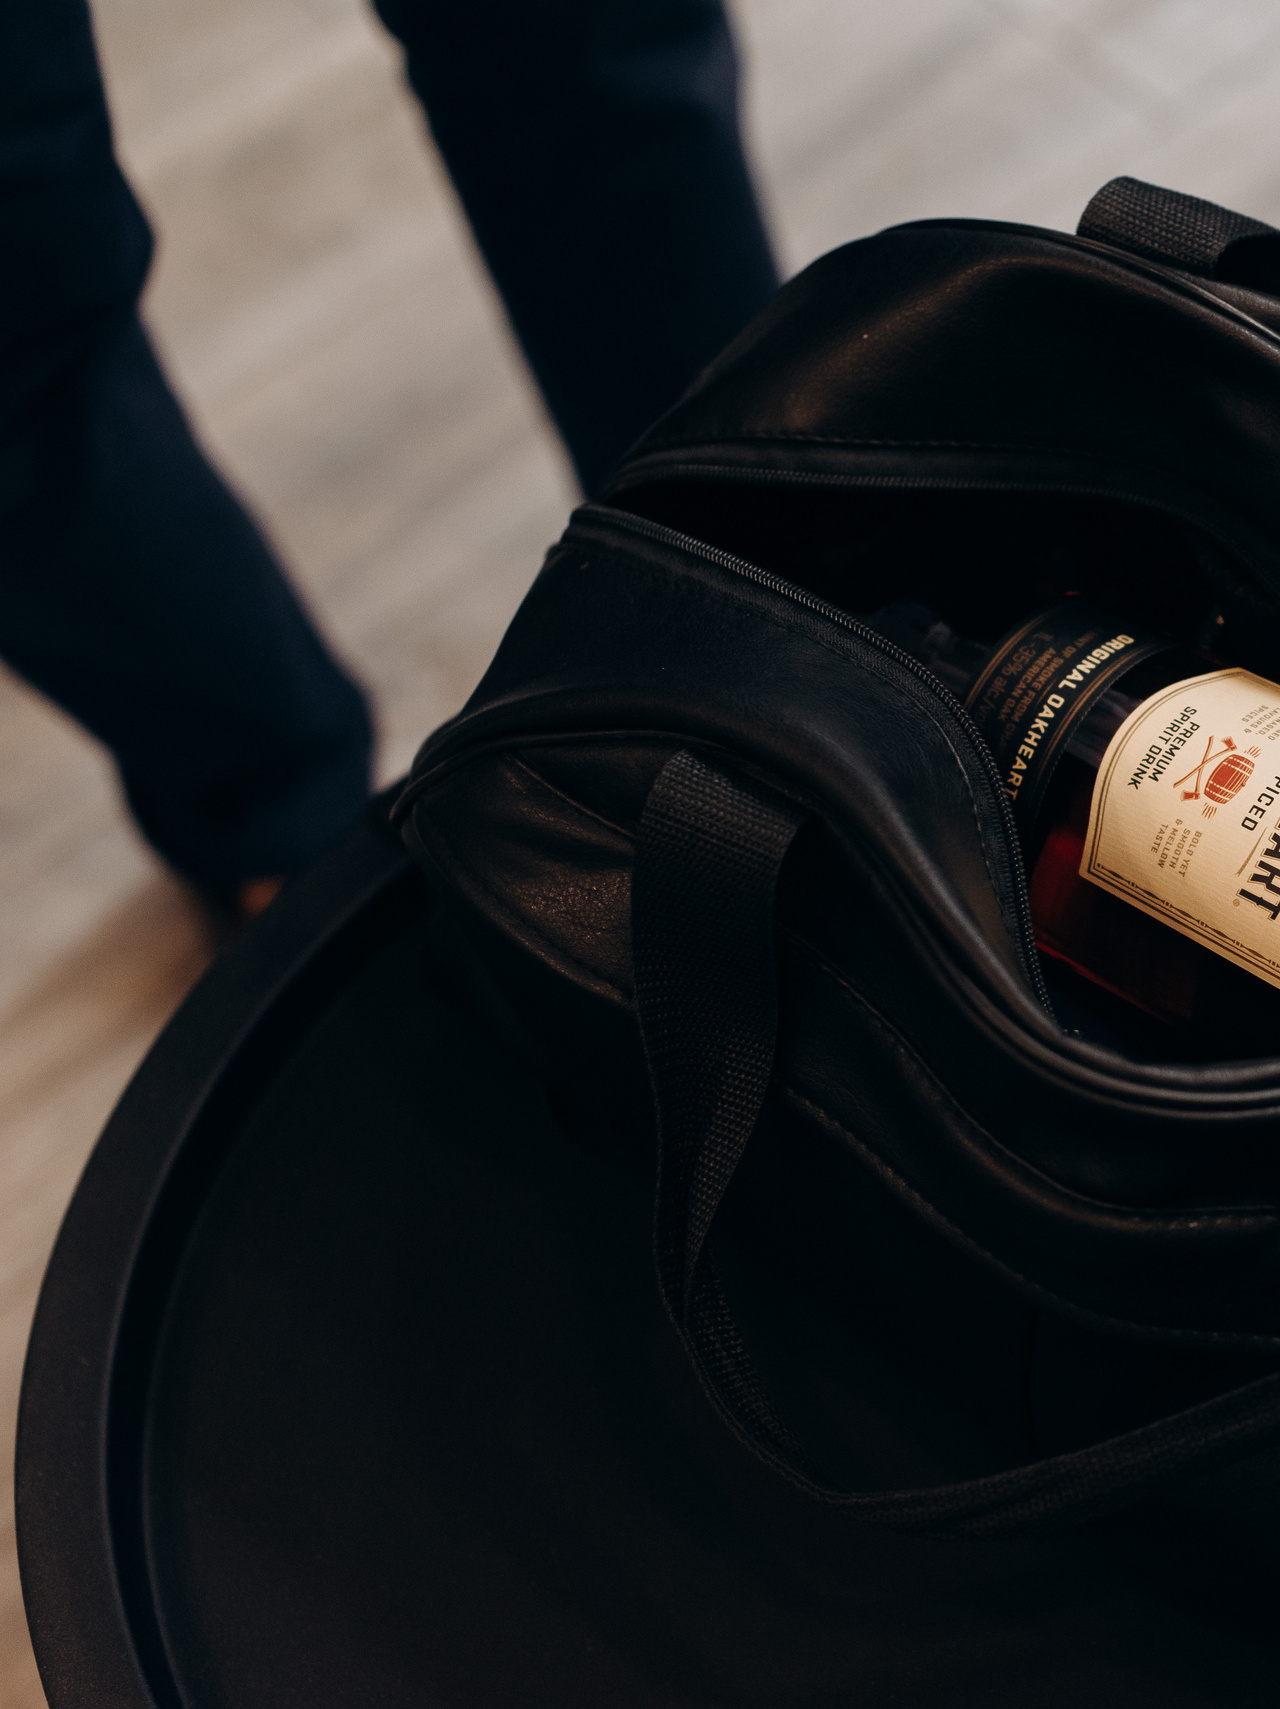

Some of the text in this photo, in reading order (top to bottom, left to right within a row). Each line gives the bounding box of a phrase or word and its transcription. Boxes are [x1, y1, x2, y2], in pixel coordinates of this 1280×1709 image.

[1029, 655, 1064, 692] SMOKE
[1060, 644, 1076, 658] OF
[995, 645, 1055, 722] AMERICAN OAK
[1008, 688, 1036, 723] FROM
[1002, 634, 1135, 801] ORIGINAL OAKHEART
[1241, 703, 1268, 723] SPICES
[1125, 704, 1195, 790] SPIRIT DRINK
[1146, 719, 1199, 783] PREMIUM
[1148, 821, 1170, 854] TASTE
[1153, 817, 1183, 869] & MELLOW
[1166, 827, 1192, 869] SMOOTH
[1174, 829, 1203, 878] BOLD YET
